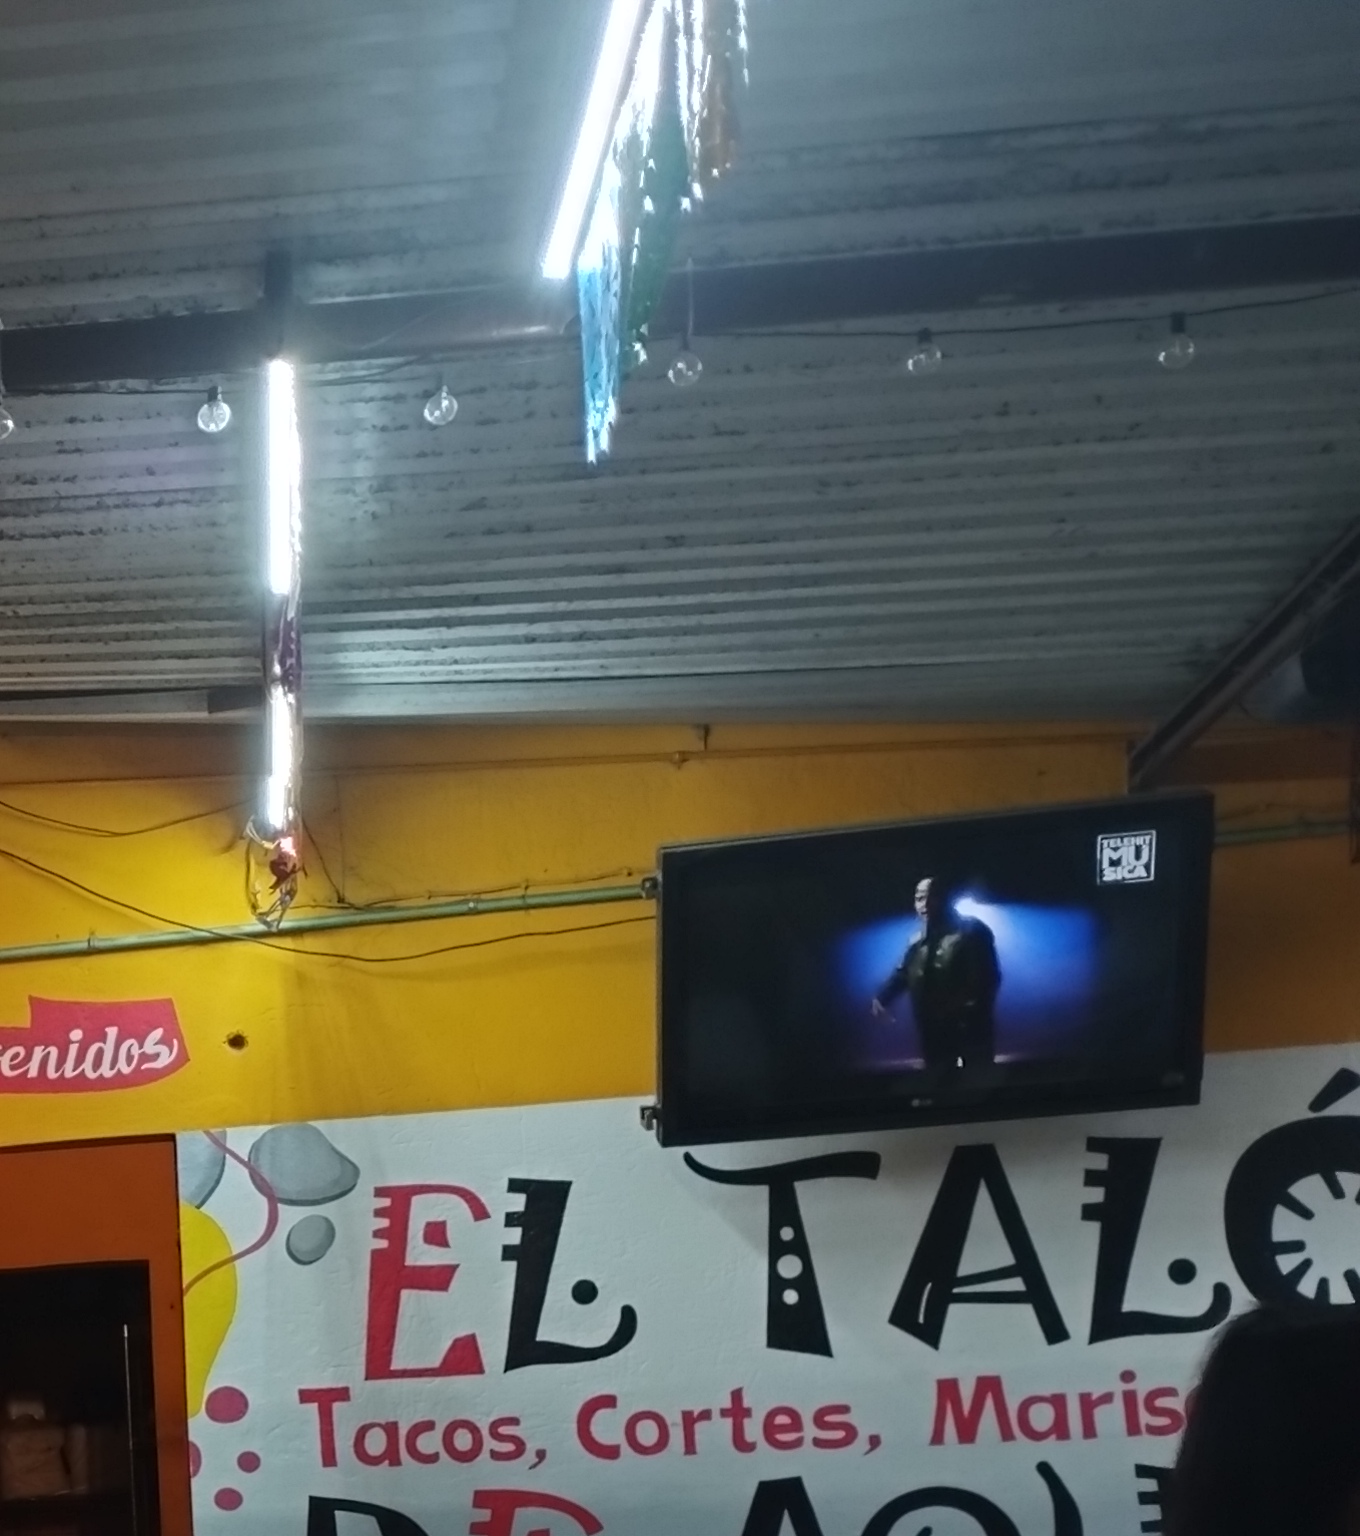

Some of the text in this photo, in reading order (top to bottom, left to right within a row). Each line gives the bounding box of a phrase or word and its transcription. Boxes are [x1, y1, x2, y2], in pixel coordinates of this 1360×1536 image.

[1101, 835, 1151, 848] TELEHIT
[1102, 865, 1148, 880] SICA
[364, 1178, 638, 1381] EL
[297, 1370, 1188, 1470] Tacos, Cortes, Maris
